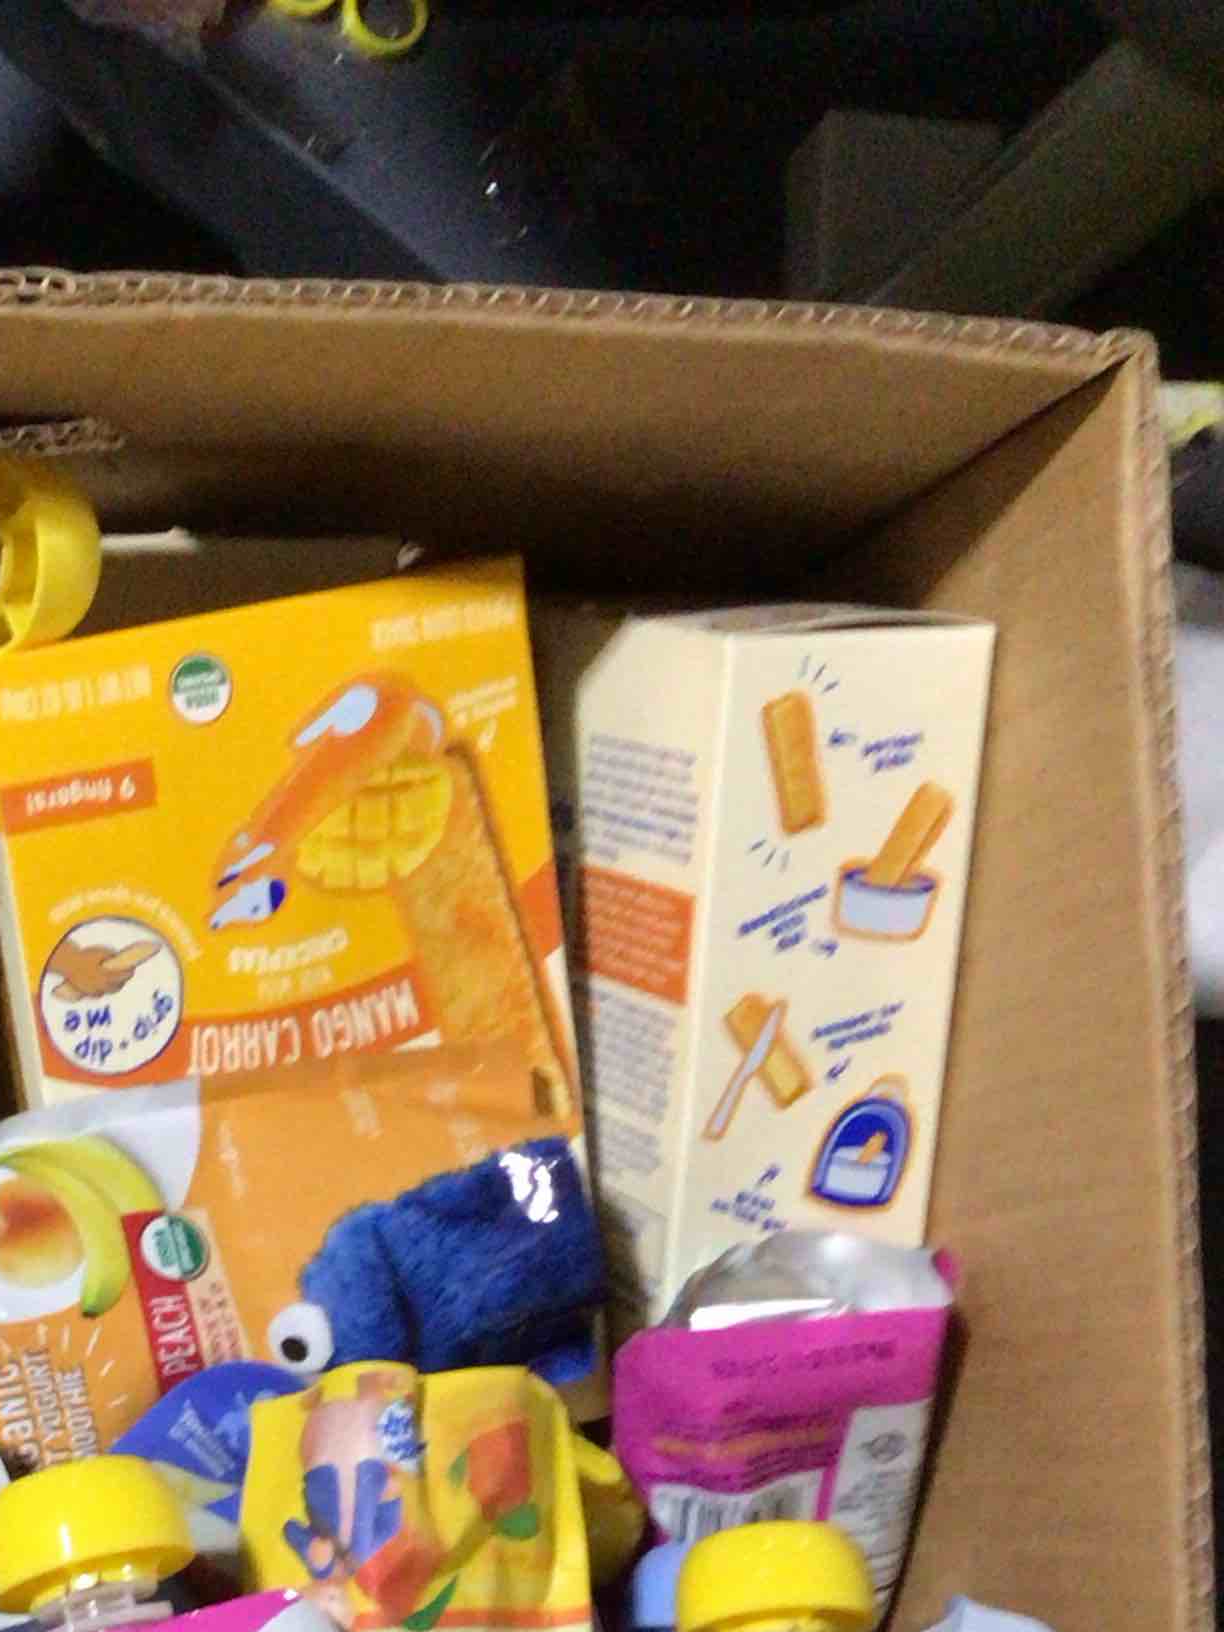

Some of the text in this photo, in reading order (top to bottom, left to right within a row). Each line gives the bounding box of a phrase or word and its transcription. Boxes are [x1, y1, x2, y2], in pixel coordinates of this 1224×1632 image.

[117, 774, 137, 800] 9
[60, 1003, 113, 1034] me
[179, 1010, 305, 1078] CARROT
[306, 977, 421, 1053] MANGO
[70, 1032, 115, 1067] dip
[148, 1290, 199, 1378] PEACH
[20, 1345, 64, 1439] YOGURT
